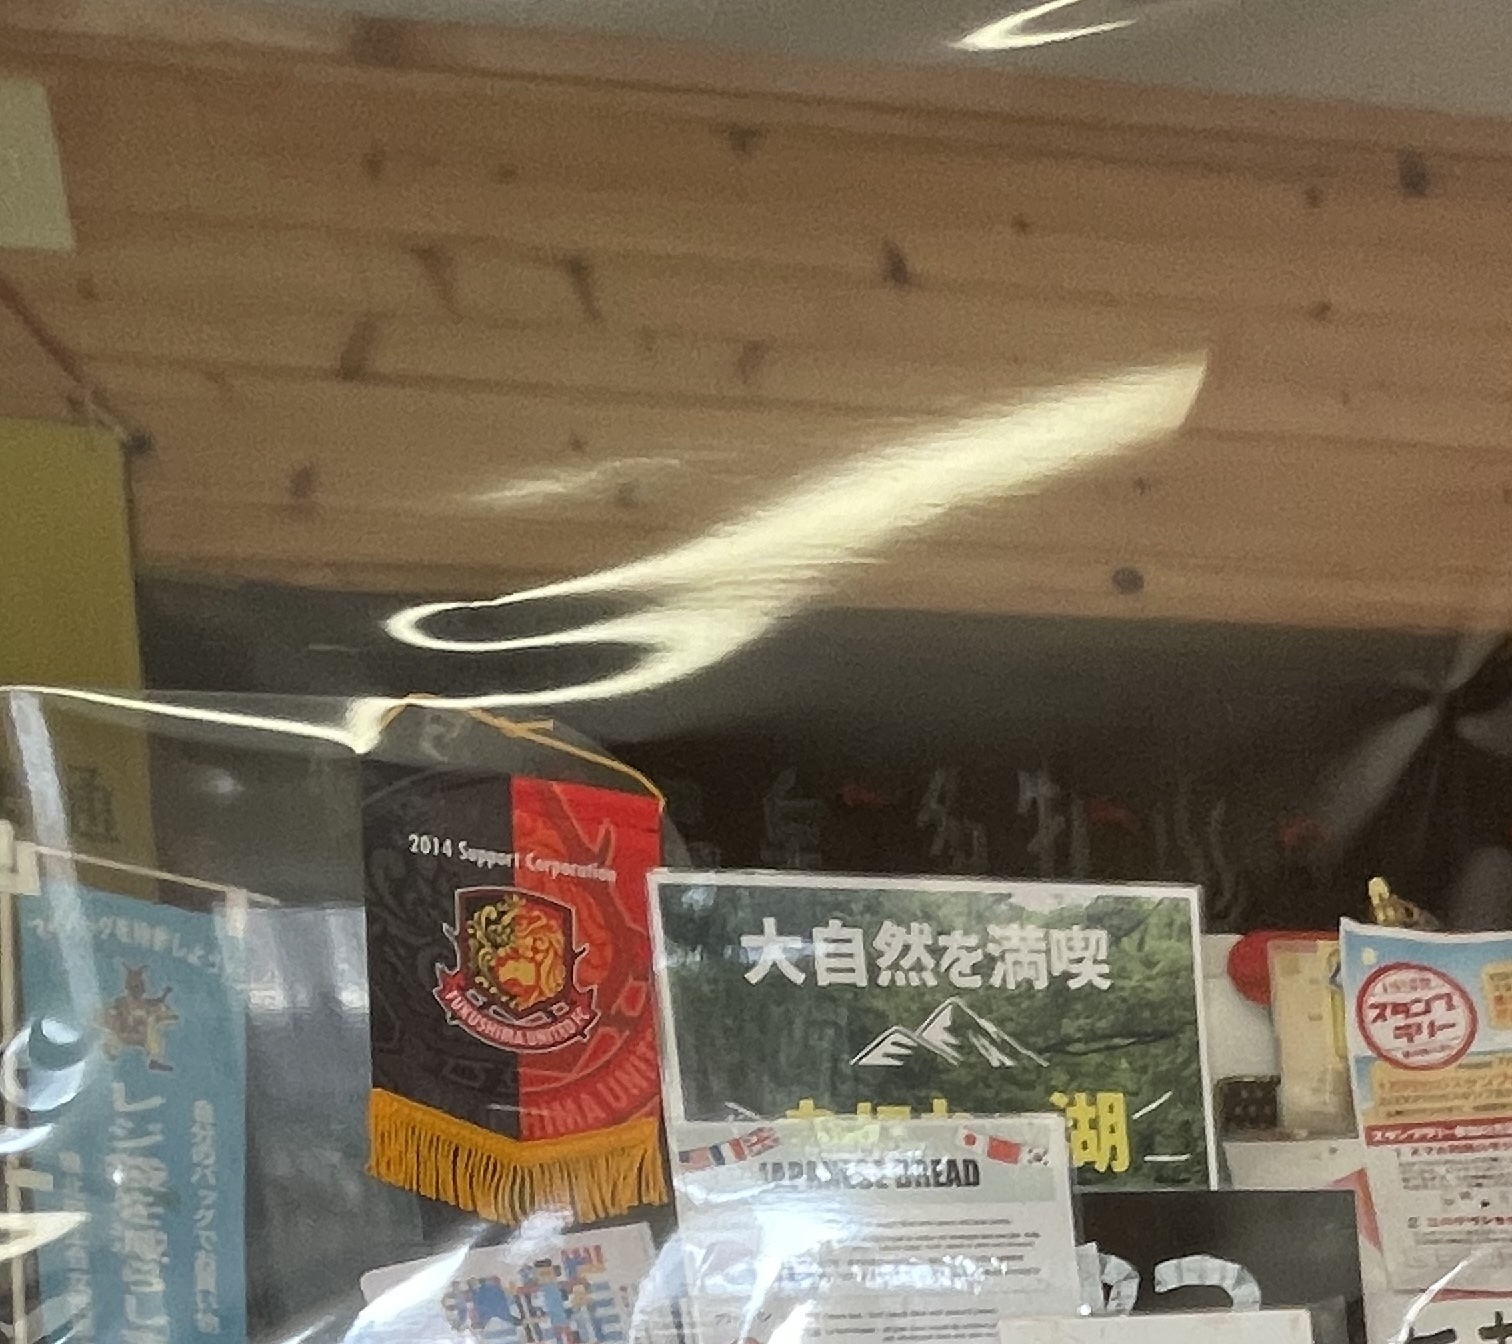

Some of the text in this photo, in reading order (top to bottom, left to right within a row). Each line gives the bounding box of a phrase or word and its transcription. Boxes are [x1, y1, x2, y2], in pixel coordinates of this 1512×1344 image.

[408, 833, 618, 883] 2014 Support Corporation
[740, 917, 1113, 991] 大自然を満喫
